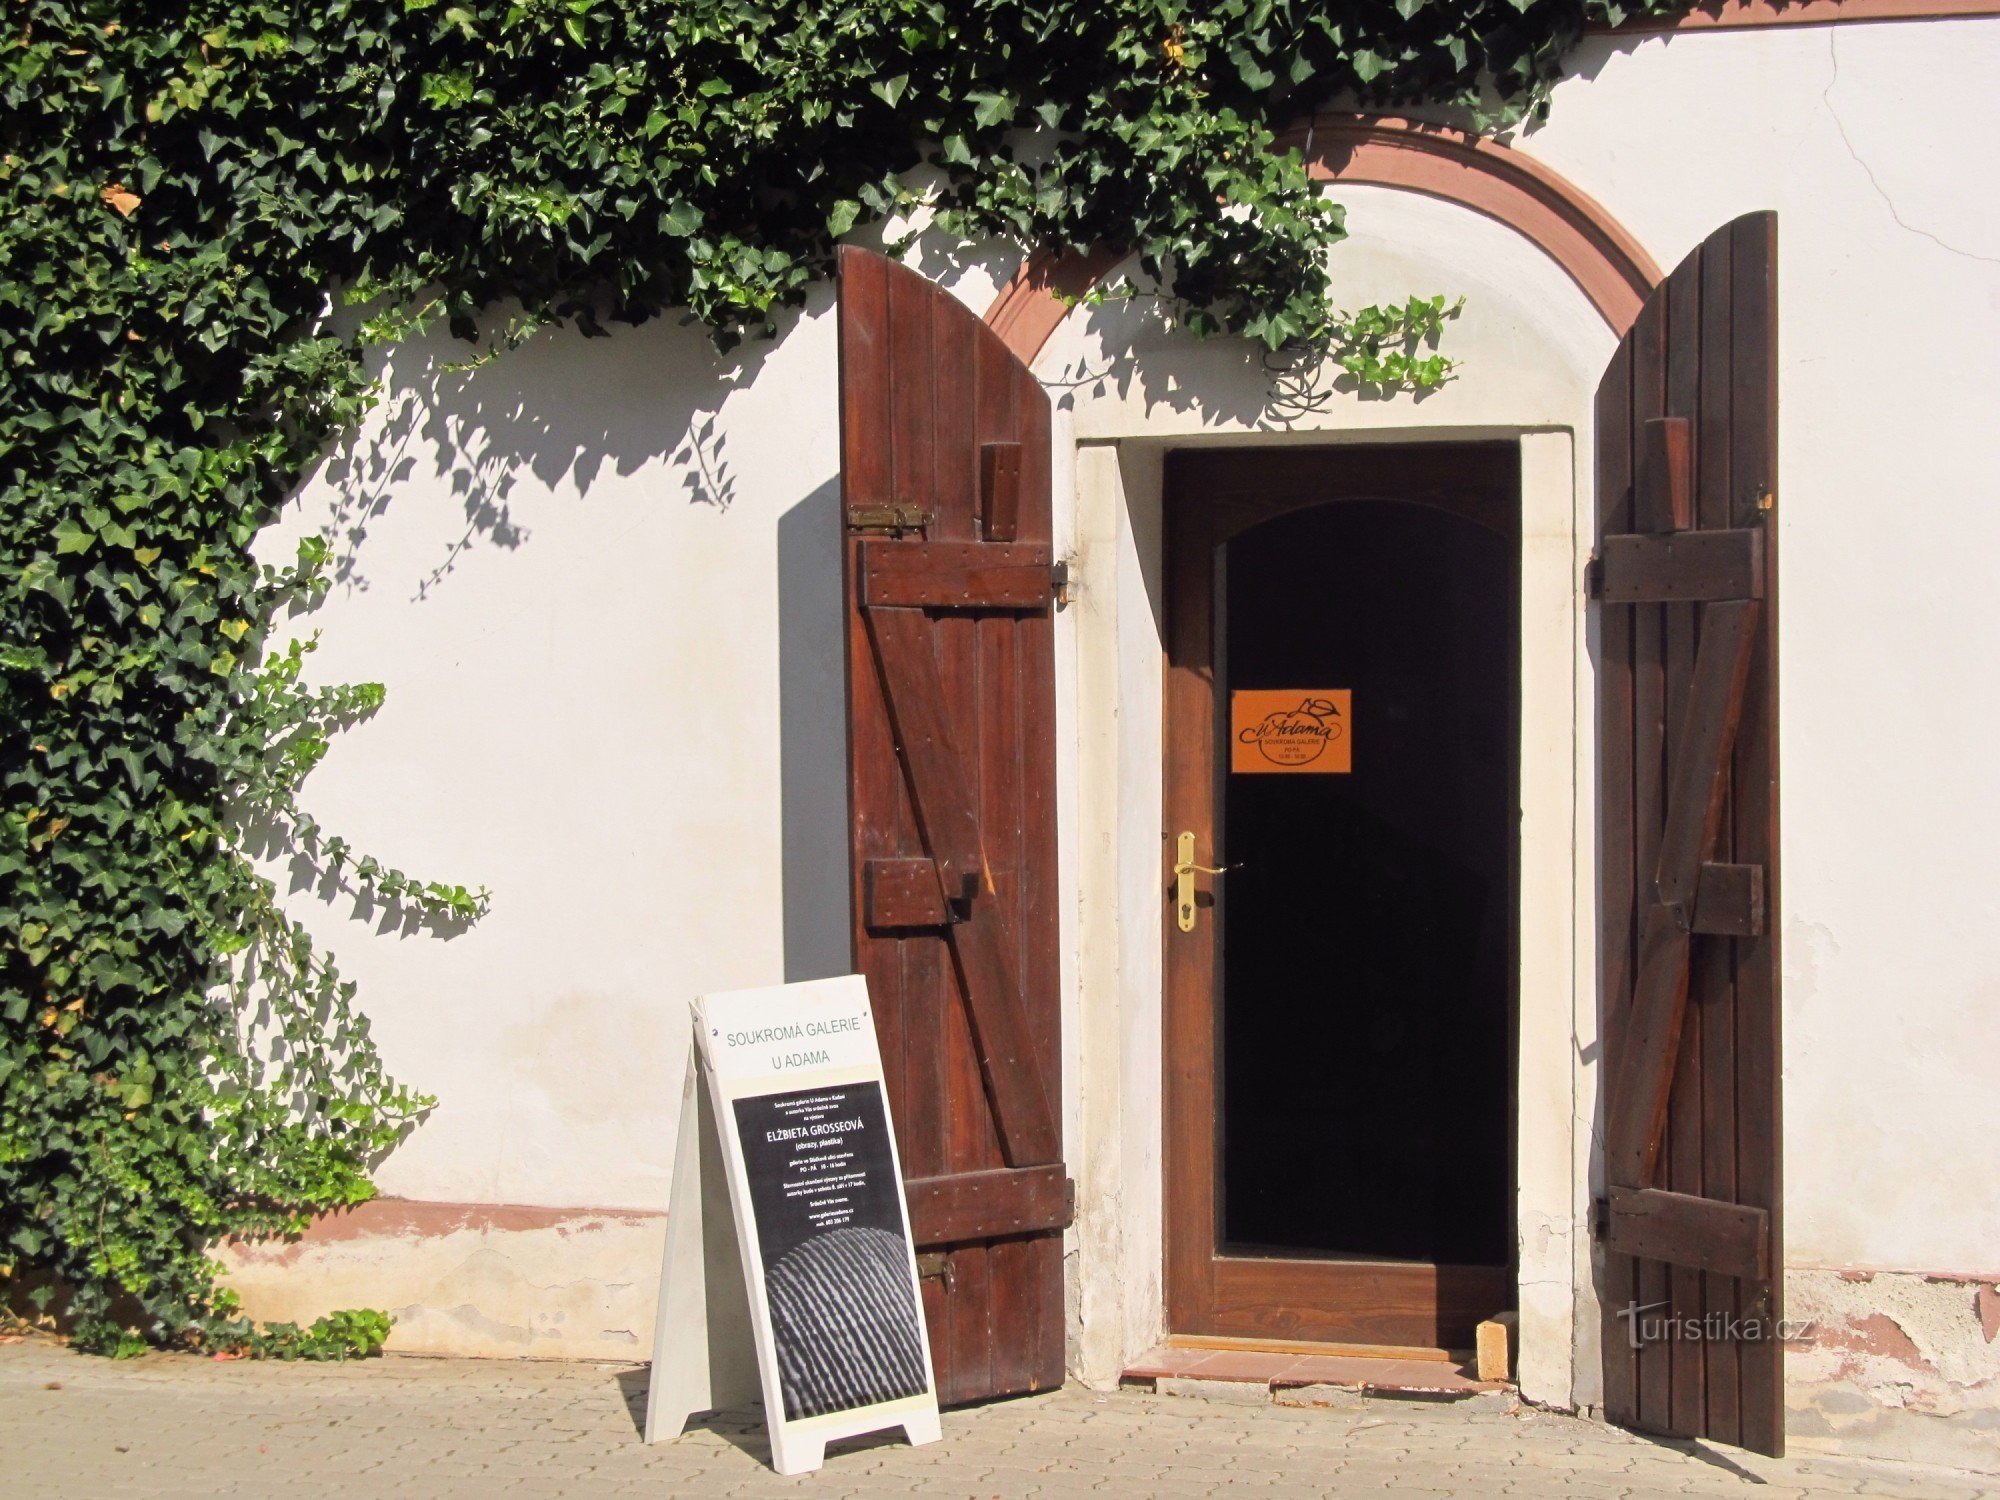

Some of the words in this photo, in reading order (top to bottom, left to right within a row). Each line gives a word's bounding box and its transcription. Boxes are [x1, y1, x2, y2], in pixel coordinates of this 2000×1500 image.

[727, 1022, 804, 1047] SOUKROMÁ
[805, 1017, 861, 1036] GALERIE
[771, 1056, 782, 1070] U
[785, 1050, 831, 1068] ADAMA
[810, 1115, 865, 1136] GROSSEOVÁ
[819, 1136, 843, 1149] plastika)
